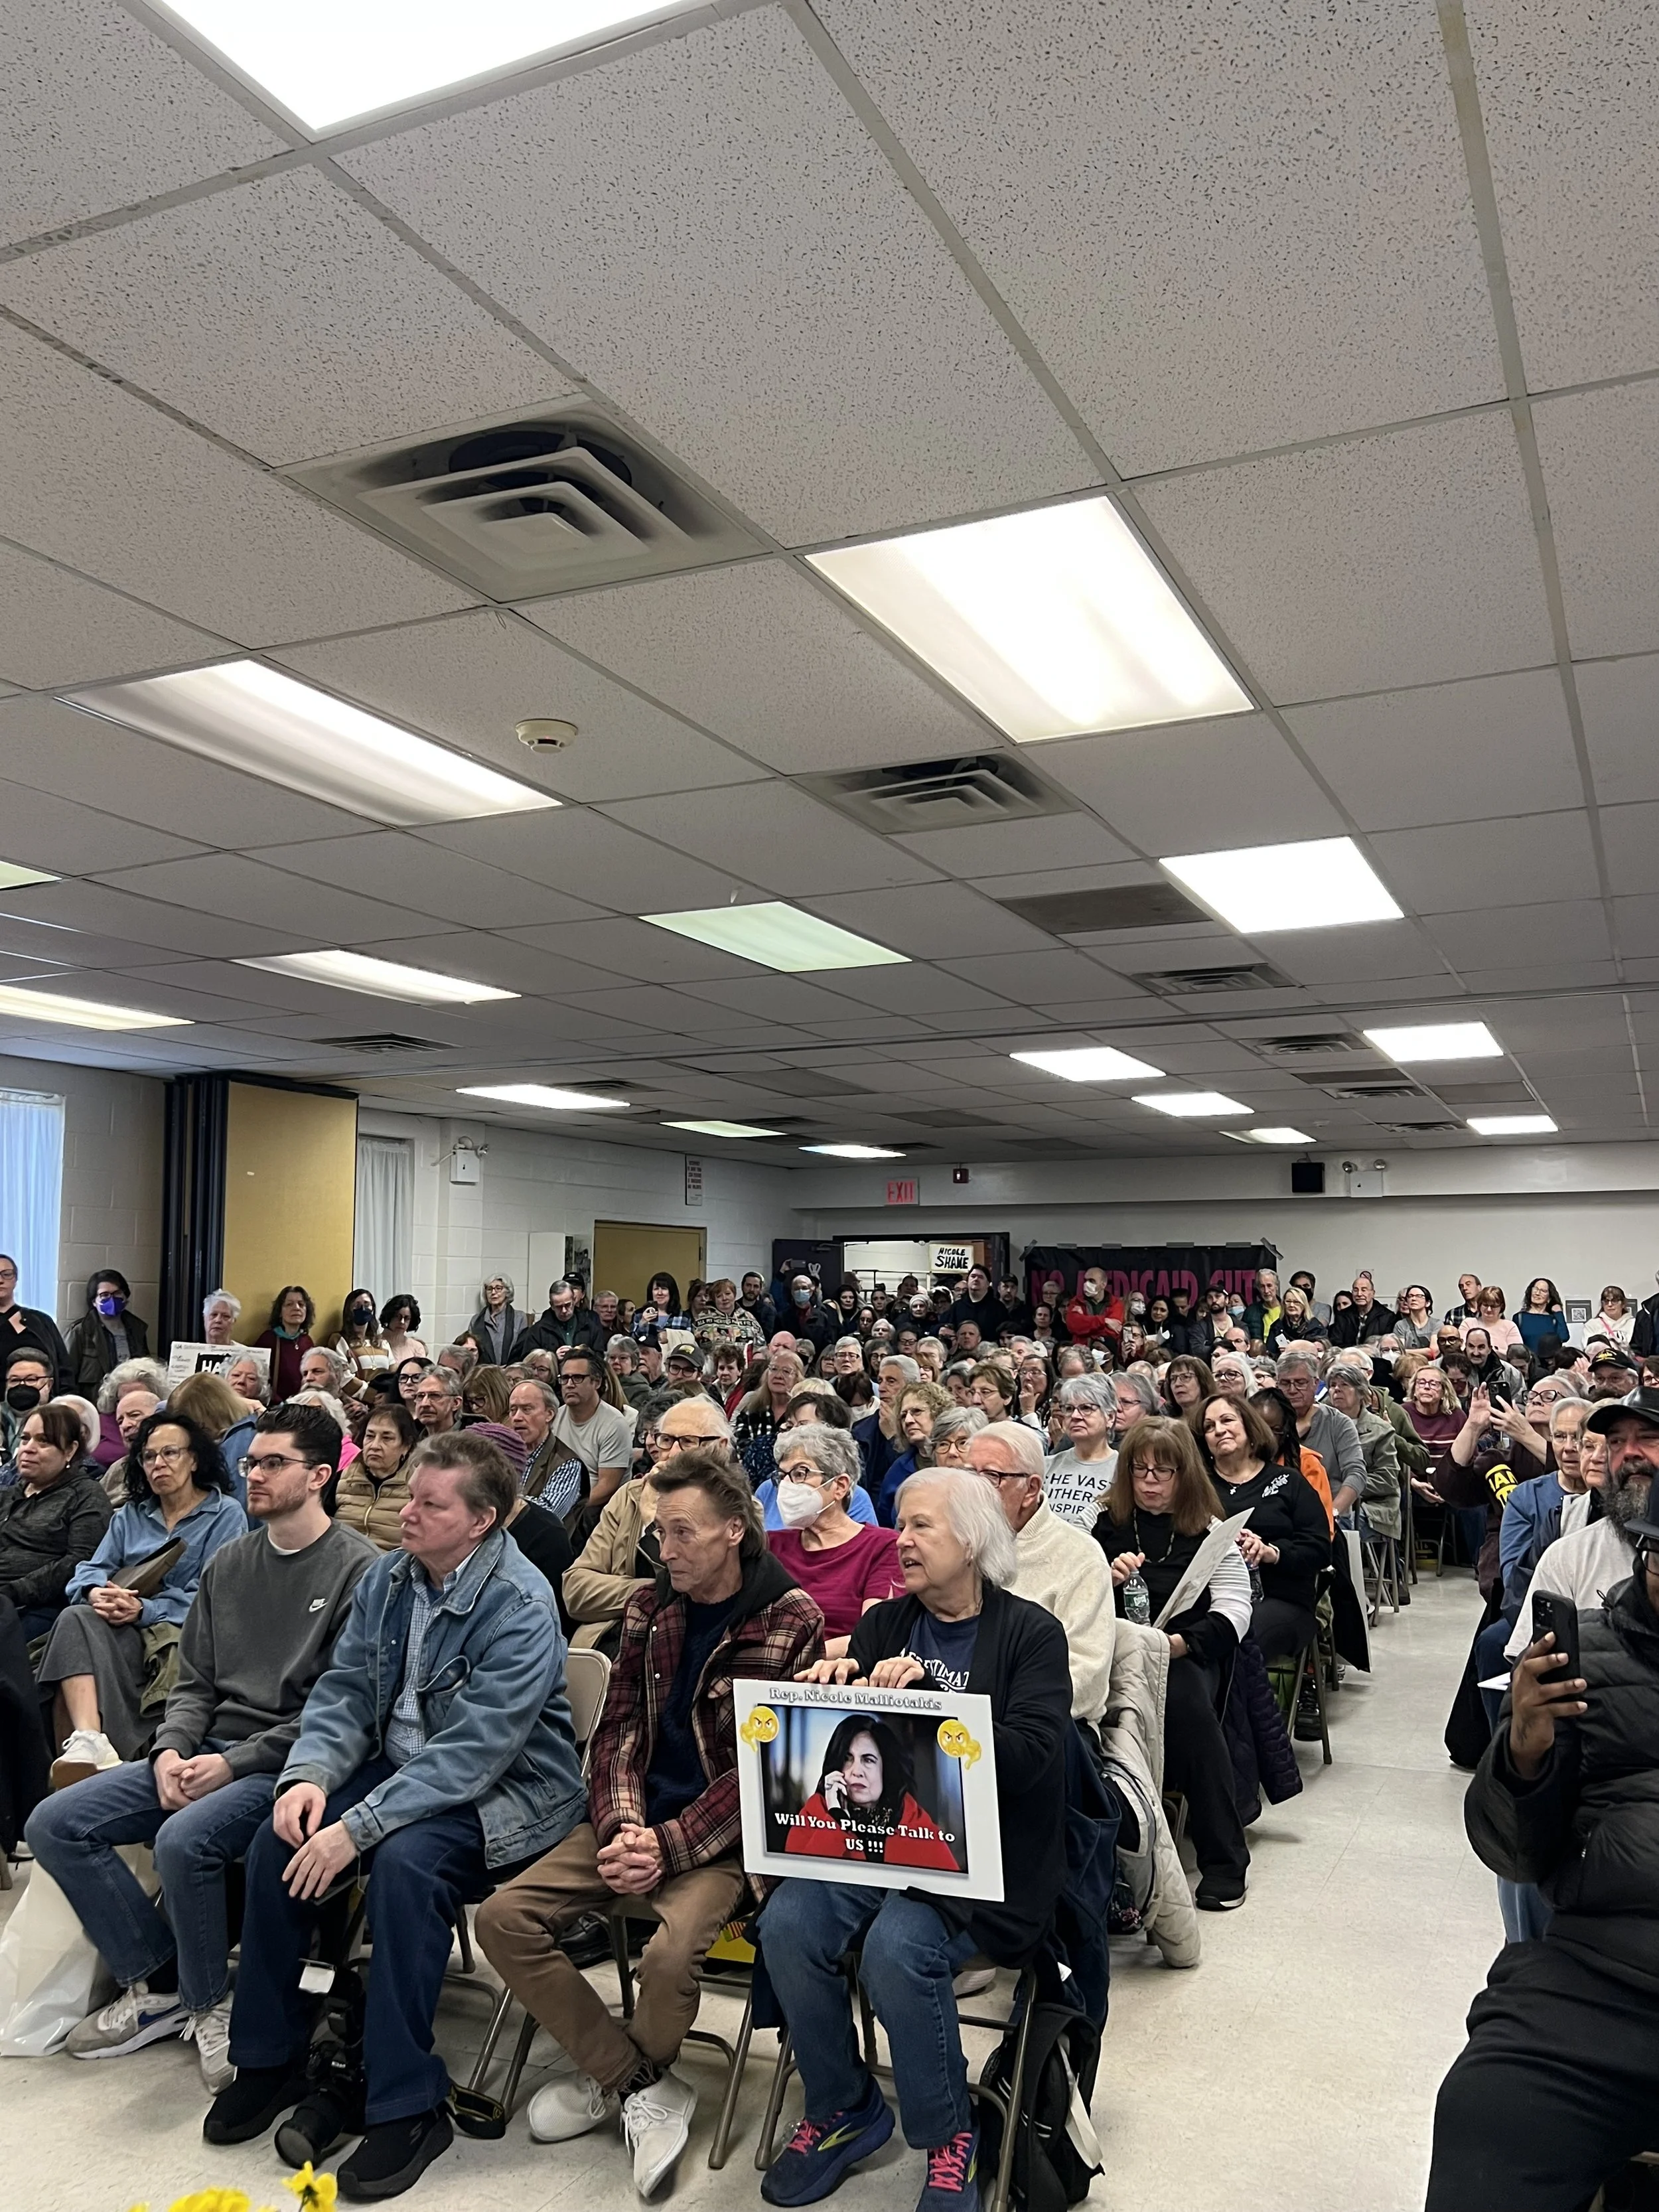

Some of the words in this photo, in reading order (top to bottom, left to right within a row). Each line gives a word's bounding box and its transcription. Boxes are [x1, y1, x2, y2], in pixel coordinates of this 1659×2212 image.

[888, 1181, 914, 1204] EXIT
[1045, 1473, 1072, 1485] HE
[1078, 1475, 1114, 1490] VAS
[770, 1687, 803, 1703] Rep.
[804, 1690, 852, 1704] Nicole
[855, 1692, 942, 1710] Malliotakis
[774, 1812, 806, 1826] Will
[807, 1816, 837, 1830] You
[839, 1818, 895, 1836] Please
[897, 1824, 935, 1840] Talk
[938, 1830, 956, 1842] to
[845, 1838, 864, 1851] US
[868, 1840, 884, 1853] !!!
